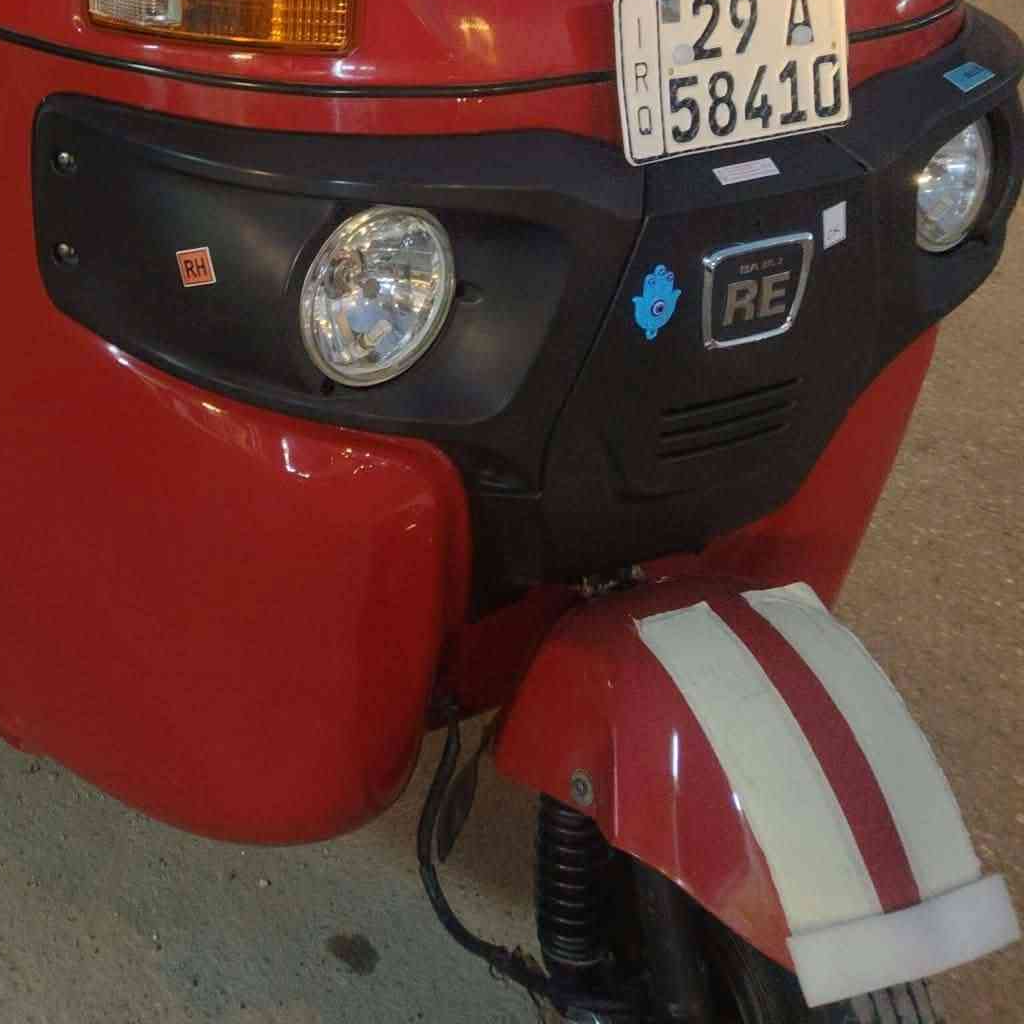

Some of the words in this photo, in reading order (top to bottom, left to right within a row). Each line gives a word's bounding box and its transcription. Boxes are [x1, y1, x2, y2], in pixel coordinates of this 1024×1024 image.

[668, 53, 842, 144] 58410
[183, 256, 209, 279] RH
[722, 270, 792, 326] RE
